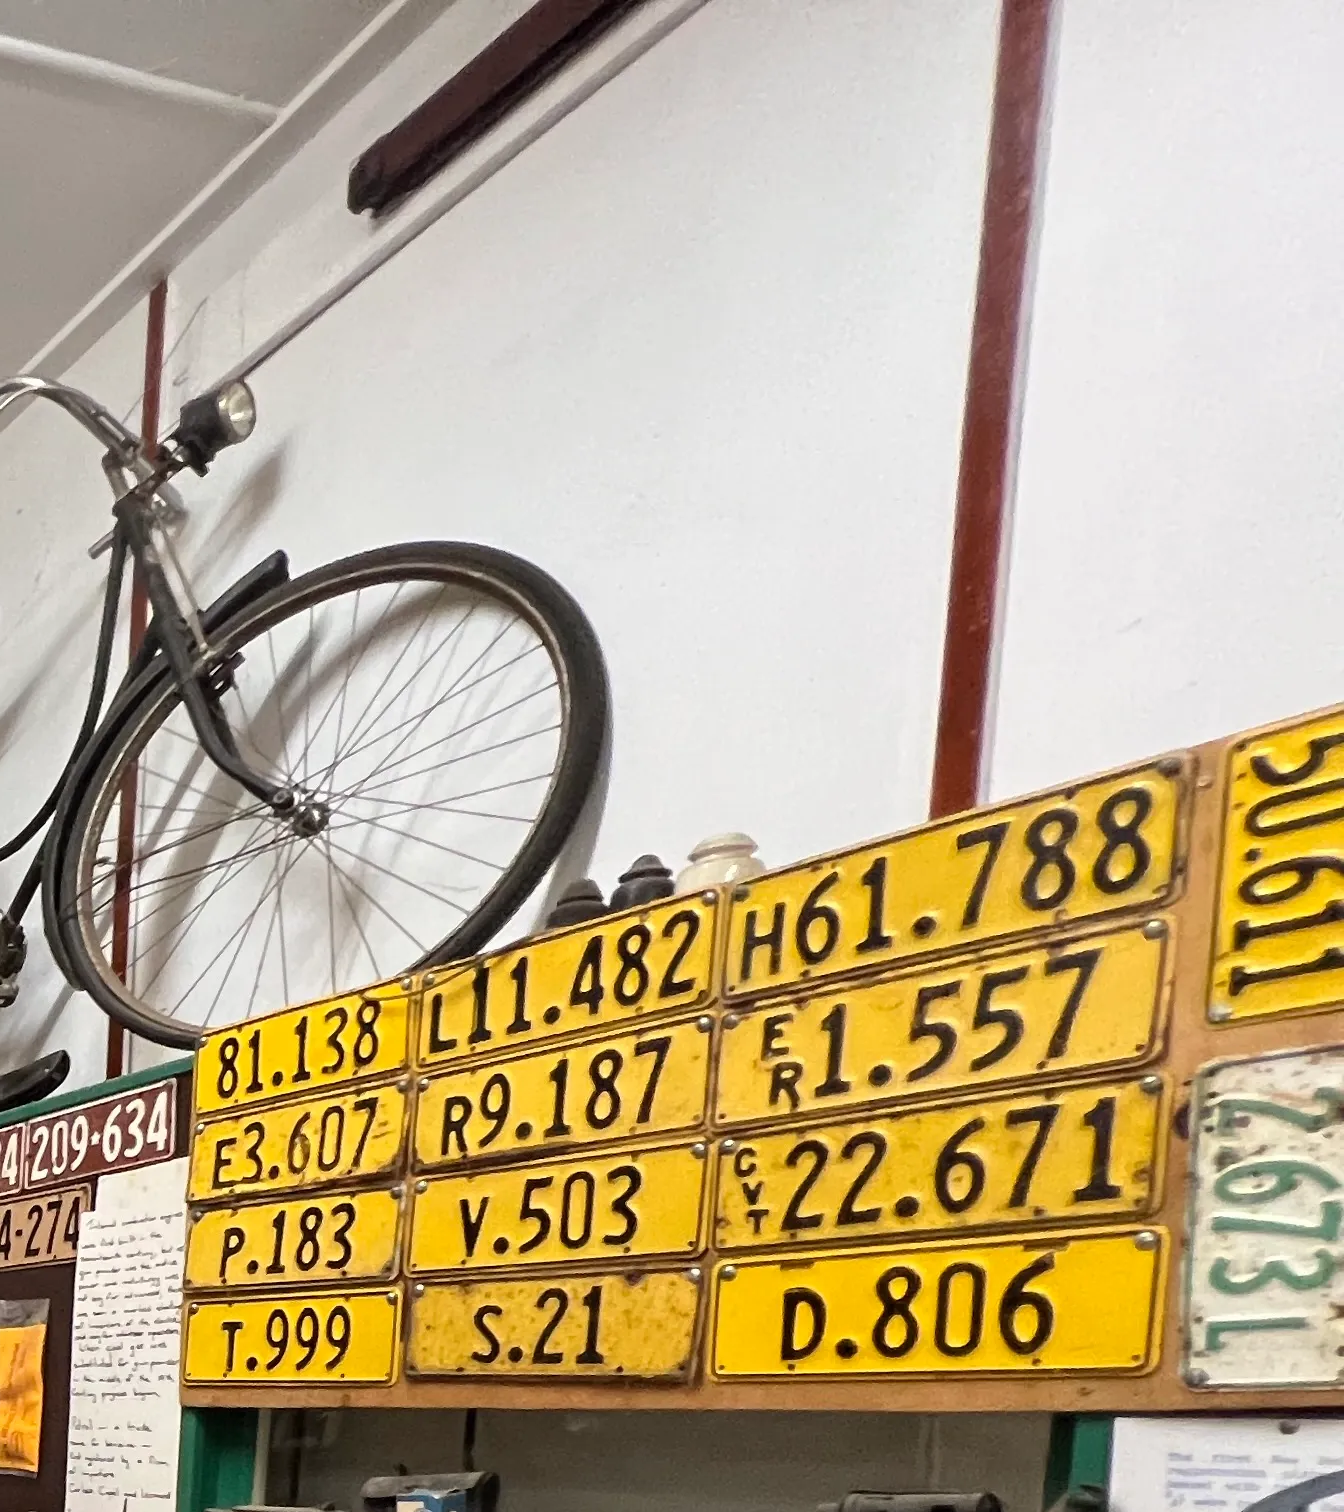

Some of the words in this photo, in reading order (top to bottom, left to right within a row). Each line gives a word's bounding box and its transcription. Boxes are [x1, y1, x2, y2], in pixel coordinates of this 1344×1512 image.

[740, 788, 1152, 987] H61.788
[427, 910, 701, 1057] L11.482
[219, 1000, 382, 1100] 81.138
[442, 1037, 672, 1158] R9.187
[213, 1097, 379, 1189] E3.607
[222, 1203, 354, 1277] P.183
[461, 1166, 644, 1258] V.503
[223, 1303, 352, 1372] T.999
[472, 1287, 606, 1364] S.21
[781, 1252, 1056, 1362] D.806
